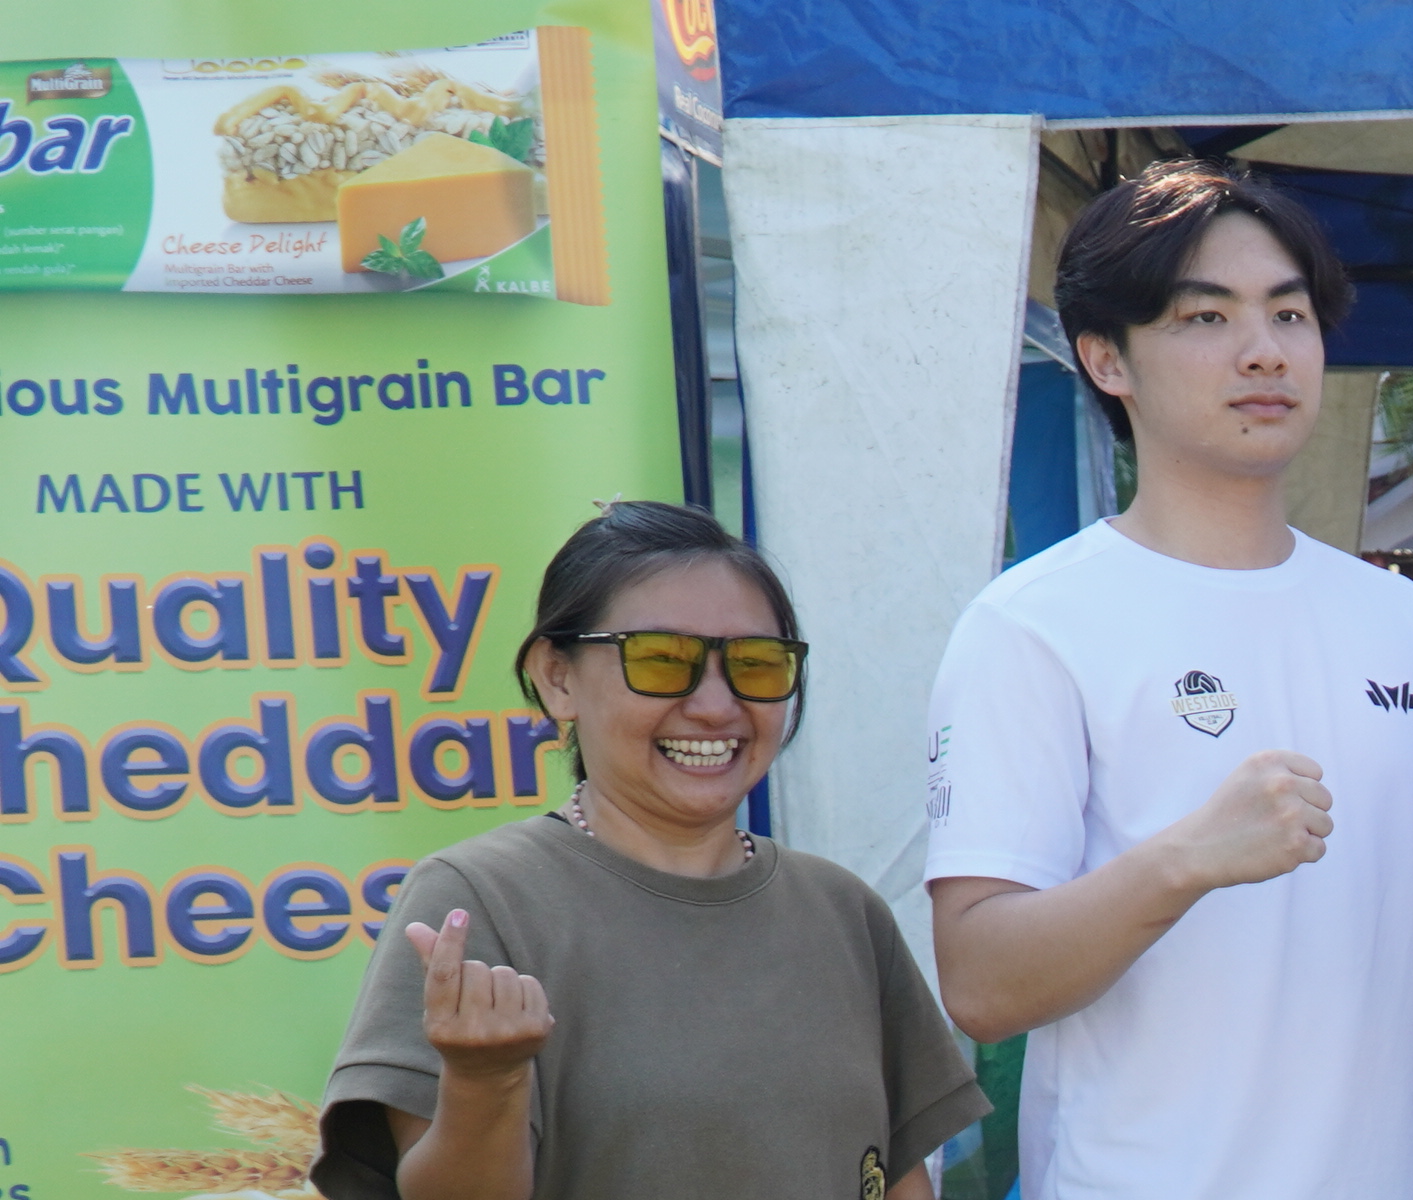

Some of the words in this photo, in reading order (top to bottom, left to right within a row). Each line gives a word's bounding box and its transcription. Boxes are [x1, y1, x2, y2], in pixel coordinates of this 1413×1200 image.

[162, 234, 243, 256] Cheese
[250, 231, 328, 259] Delight
[228, 263, 246, 275] Bar
[249, 262, 275, 275] with
[274, 275, 314, 287] Cheese
[496, 280, 550, 293] KALBE
[147, 360, 472, 426] Multigrain
[492, 363, 607, 409] Bar
[36, 472, 202, 515] MADE
[219, 469, 365, 514] WITH
[1171, 693, 1239, 714] WESTSIDE
